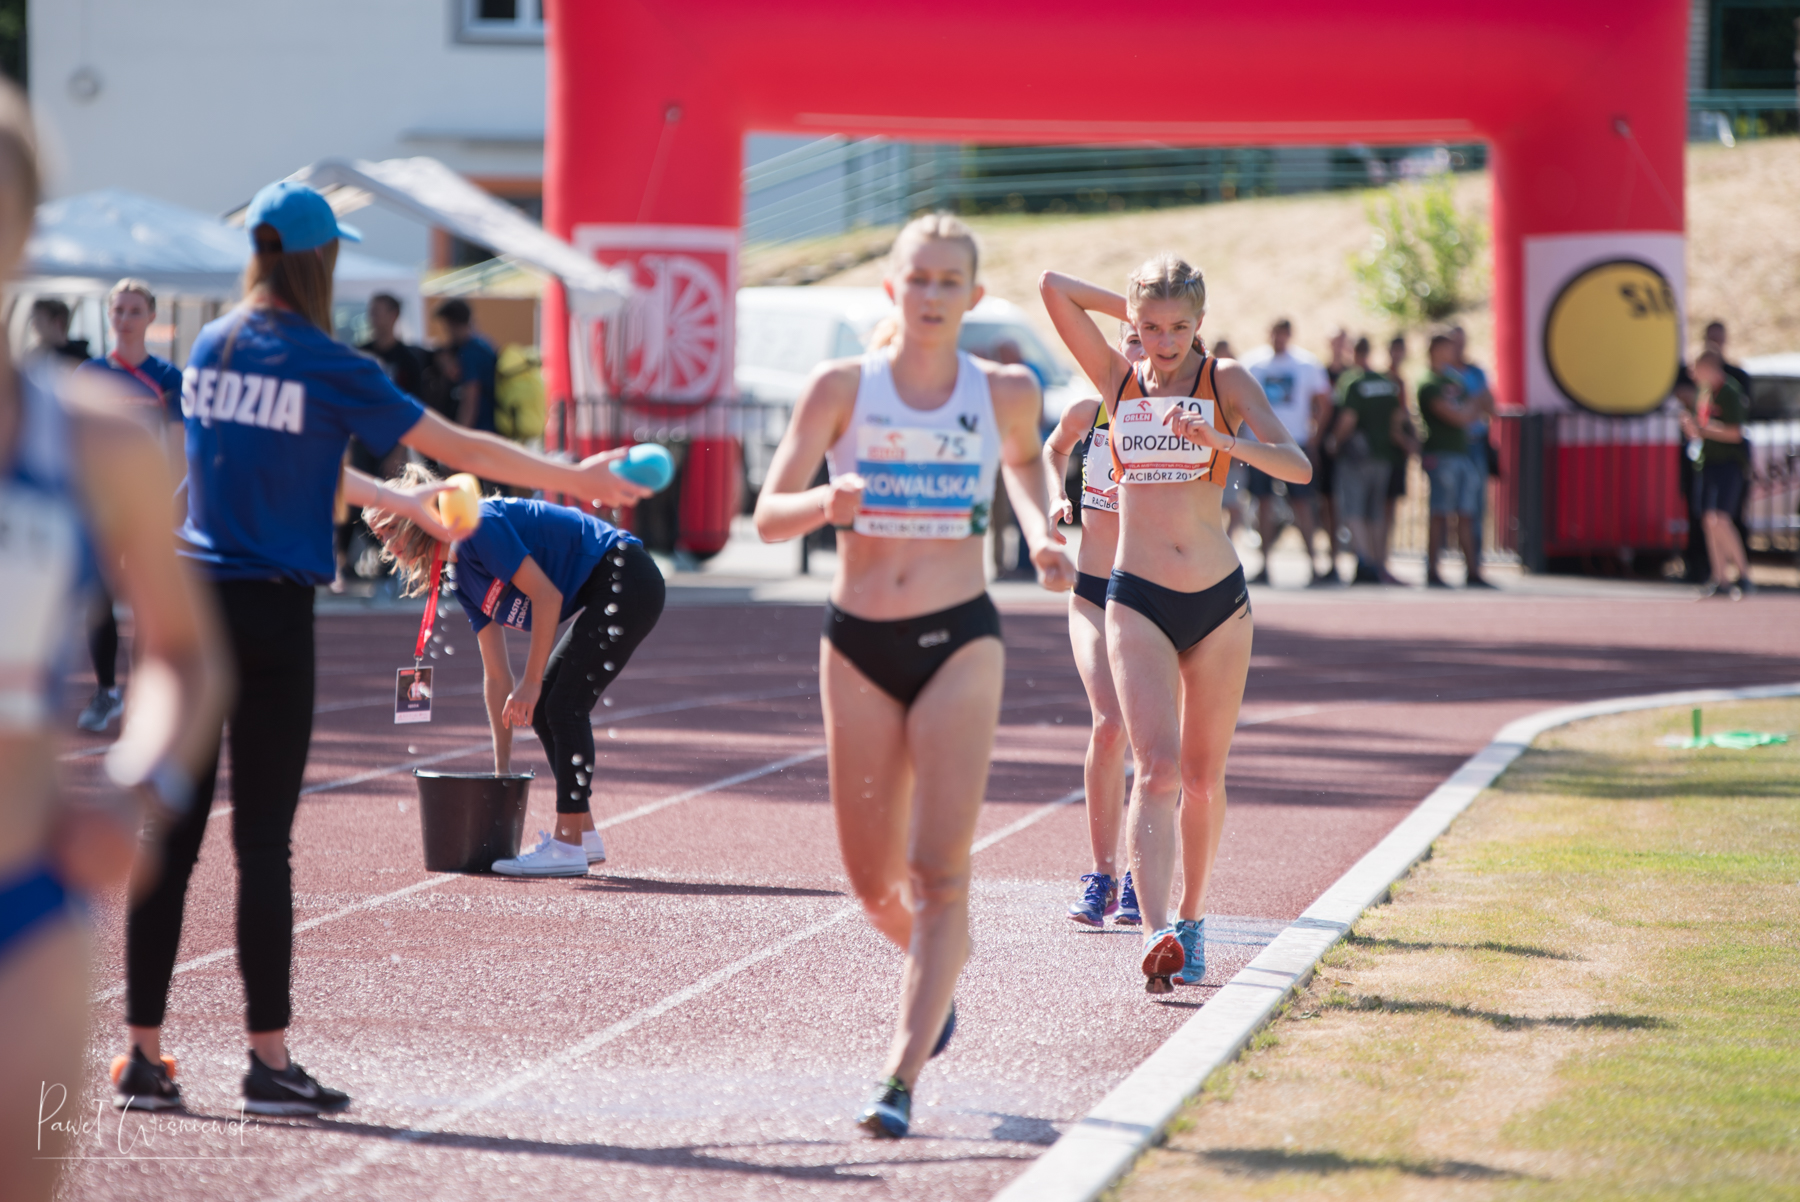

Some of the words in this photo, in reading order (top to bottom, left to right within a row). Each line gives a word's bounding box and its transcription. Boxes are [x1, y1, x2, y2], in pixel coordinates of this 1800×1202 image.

[181, 366, 305, 434] SĘDZIA
[1124, 414, 1151, 423] ORLEN
[935, 434, 966, 458] 75
[864, 473, 977, 498] KOWALSKA
